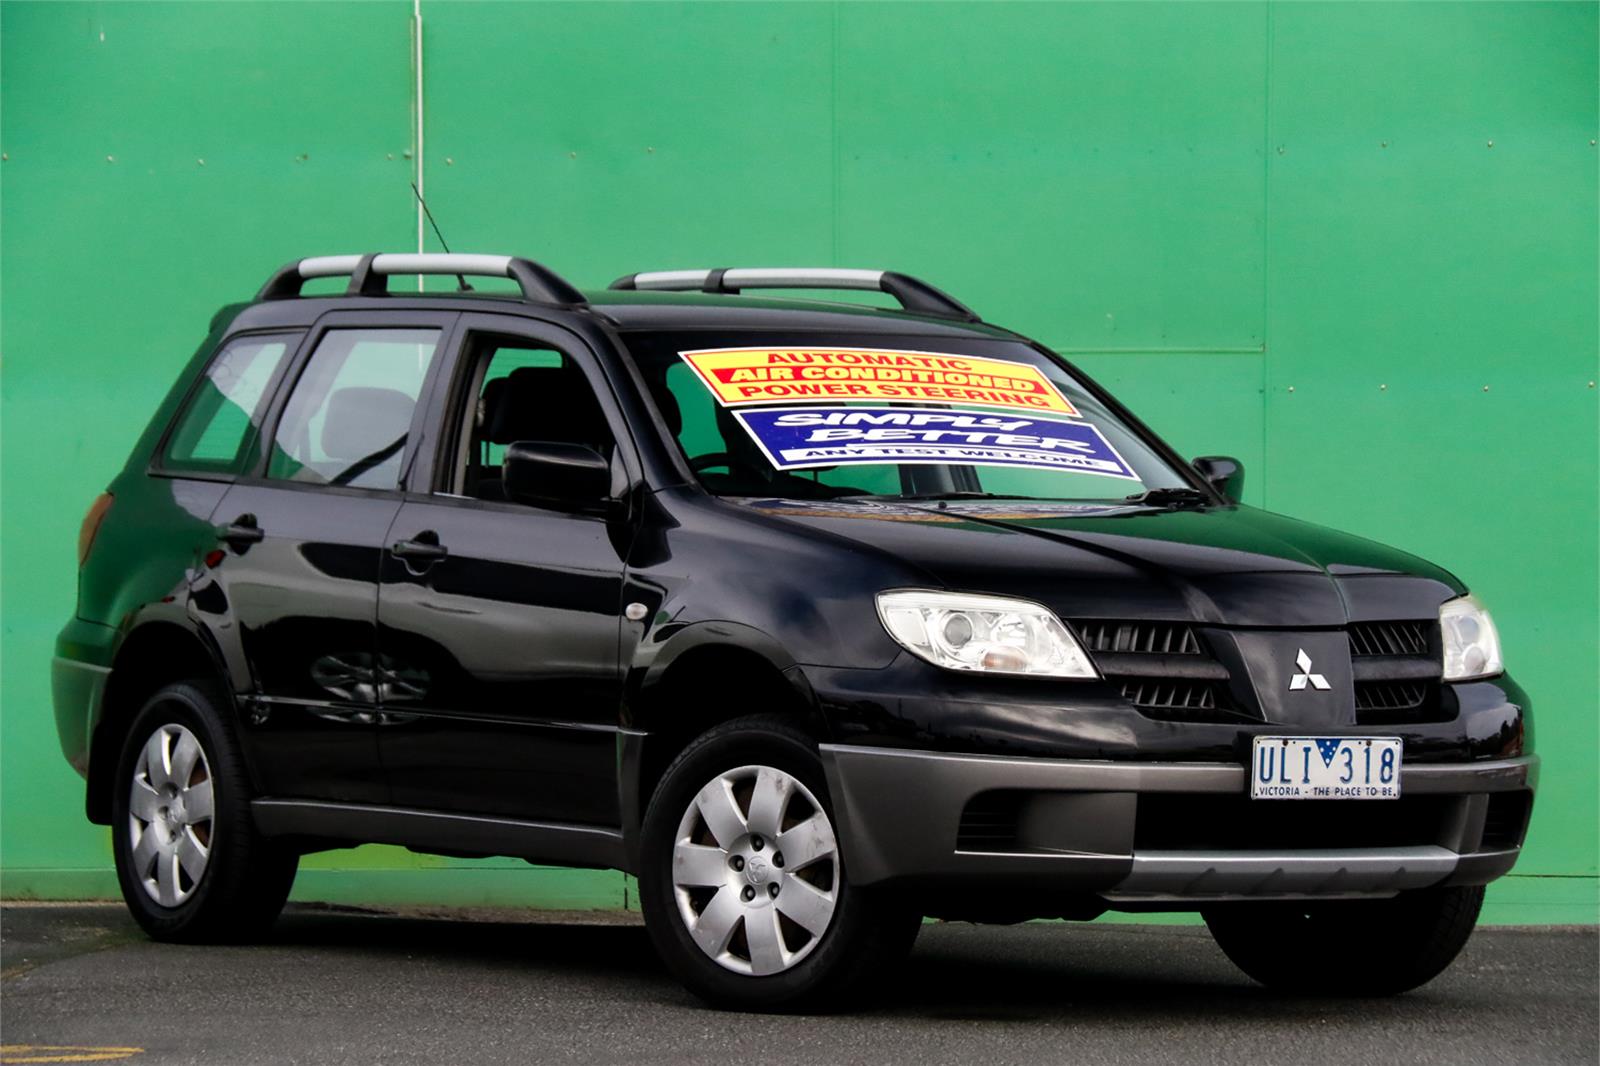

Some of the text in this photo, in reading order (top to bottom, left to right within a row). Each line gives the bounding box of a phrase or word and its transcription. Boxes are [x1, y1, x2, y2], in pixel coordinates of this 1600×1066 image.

[767, 353, 973, 371] AUTOMATIC
[730, 367, 1036, 392] AIR CONDITIONED
[737, 384, 1051, 407] POWER STEERING
[773, 412, 1033, 431] SIMPLY
[804, 428, 1096, 454] BETTER
[805, 448, 1102, 467] ANY TEST WELCOME
[1259, 746, 1395, 784] ULI 318
[1259, 786, 1300, 796] VICTORIA
[1313, 786, 1330, 796] THE
[1334, 786, 1361, 796] PLACE
[1366, 786, 1378, 796] TO
[1382, 786, 1393, 796] BE
